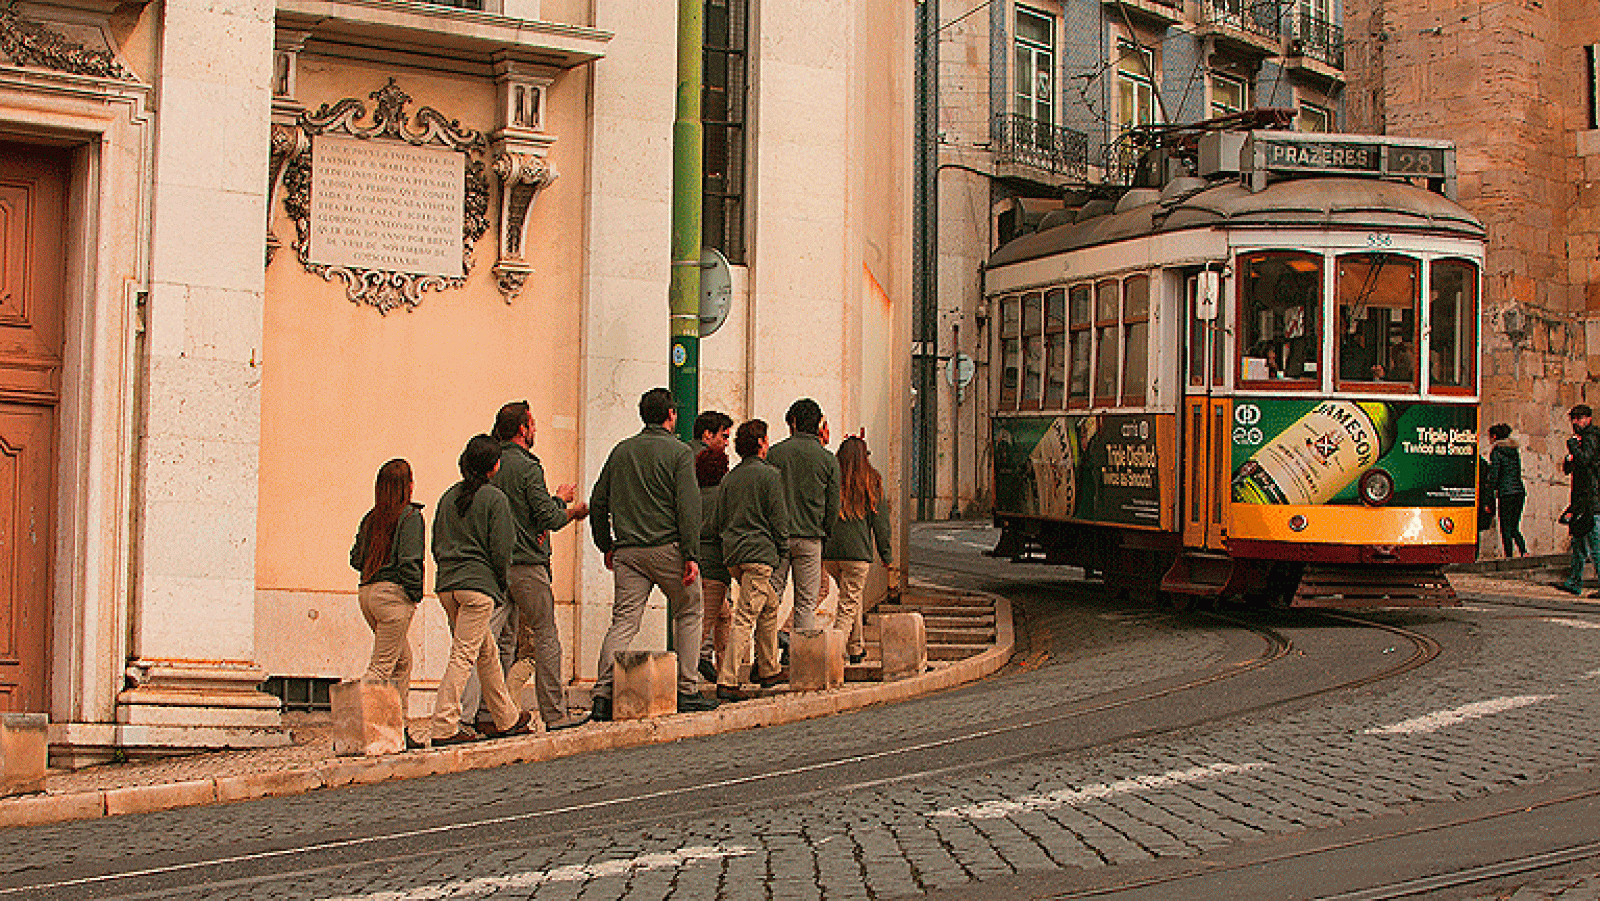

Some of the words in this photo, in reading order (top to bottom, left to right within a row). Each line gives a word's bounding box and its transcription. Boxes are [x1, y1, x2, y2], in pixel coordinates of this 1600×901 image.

[1273, 145, 1368, 167] PRAZERES
[1399, 153, 1432, 173] 28
[1313, 404, 1372, 468] JAMESON
[1416, 427, 1449, 445] Triple
[1106, 444, 1126, 470] Triple
[1402, 441, 1434, 455] Twice
